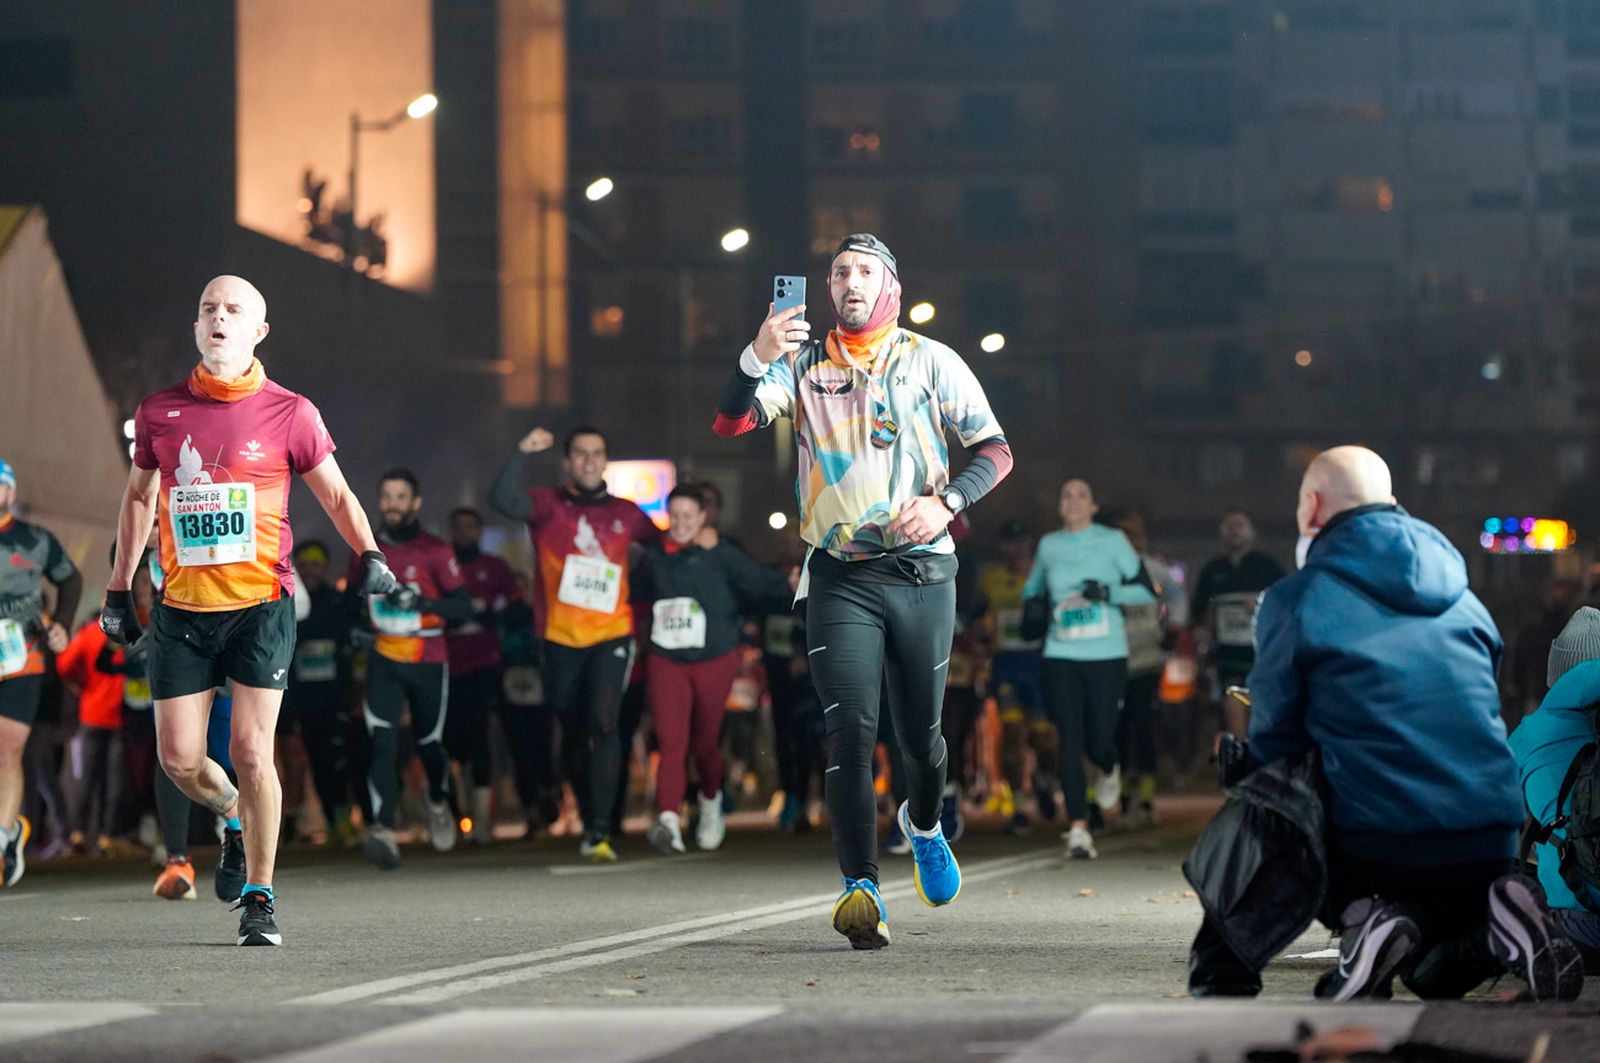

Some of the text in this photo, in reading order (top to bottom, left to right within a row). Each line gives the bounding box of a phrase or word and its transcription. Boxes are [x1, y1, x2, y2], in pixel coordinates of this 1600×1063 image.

[186, 492, 220, 502] NOCHE DE
[177, 504, 192, 513] SAN
[179, 512, 244, 538] 13830
